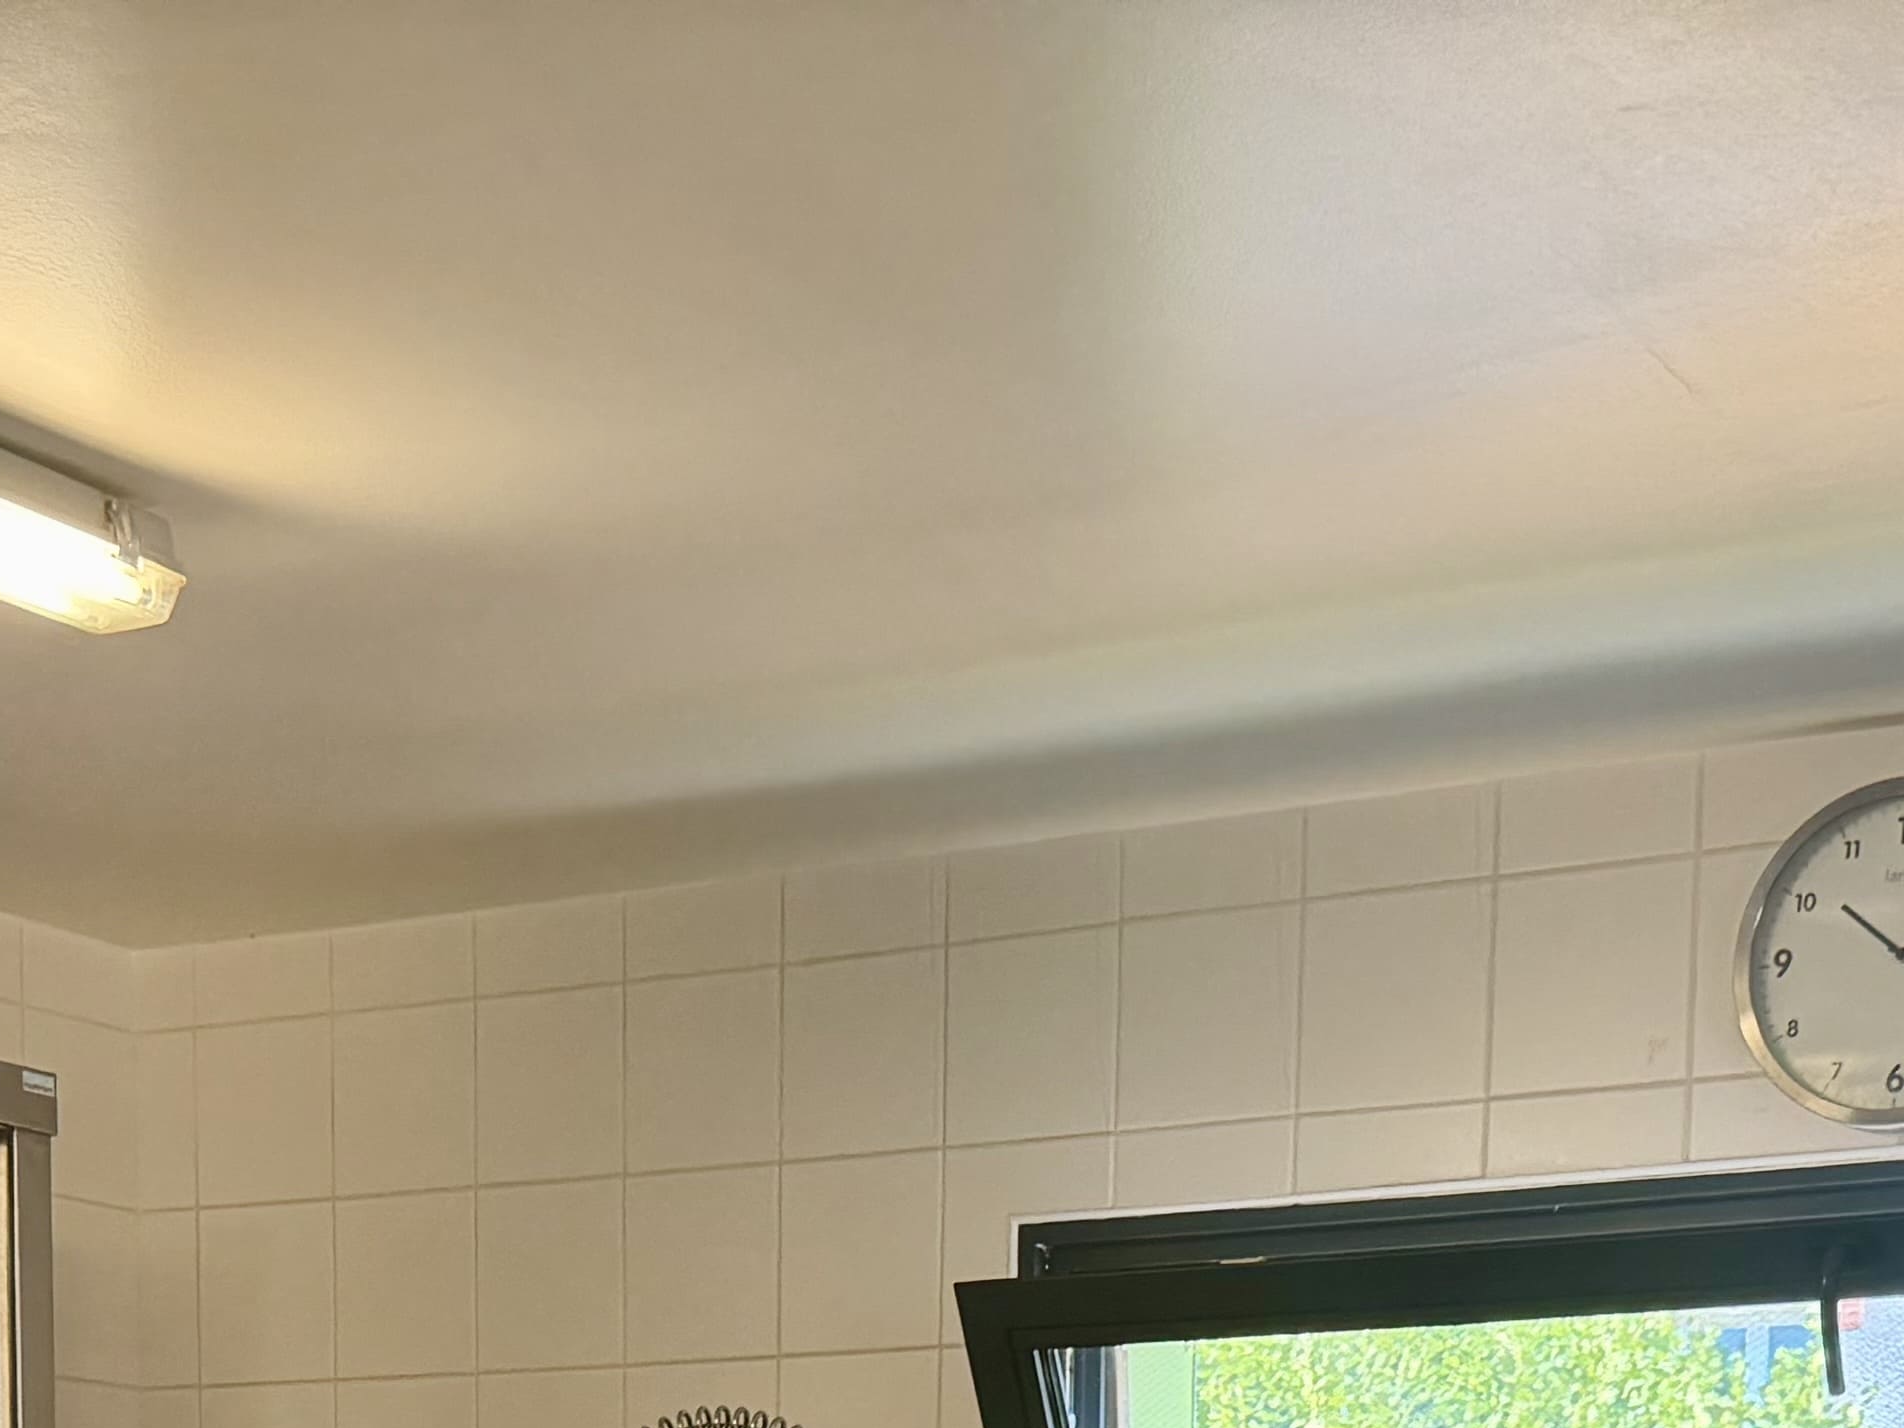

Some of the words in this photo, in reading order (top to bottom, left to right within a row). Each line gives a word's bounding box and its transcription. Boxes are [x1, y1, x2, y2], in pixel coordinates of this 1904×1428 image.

[1844, 840, 1861, 860] 11
[1795, 892, 1817, 913] 10
[1773, 948, 1793, 978] 9
[1786, 1019, 1800, 1038] 8
[1831, 1061, 1843, 1081] 7
